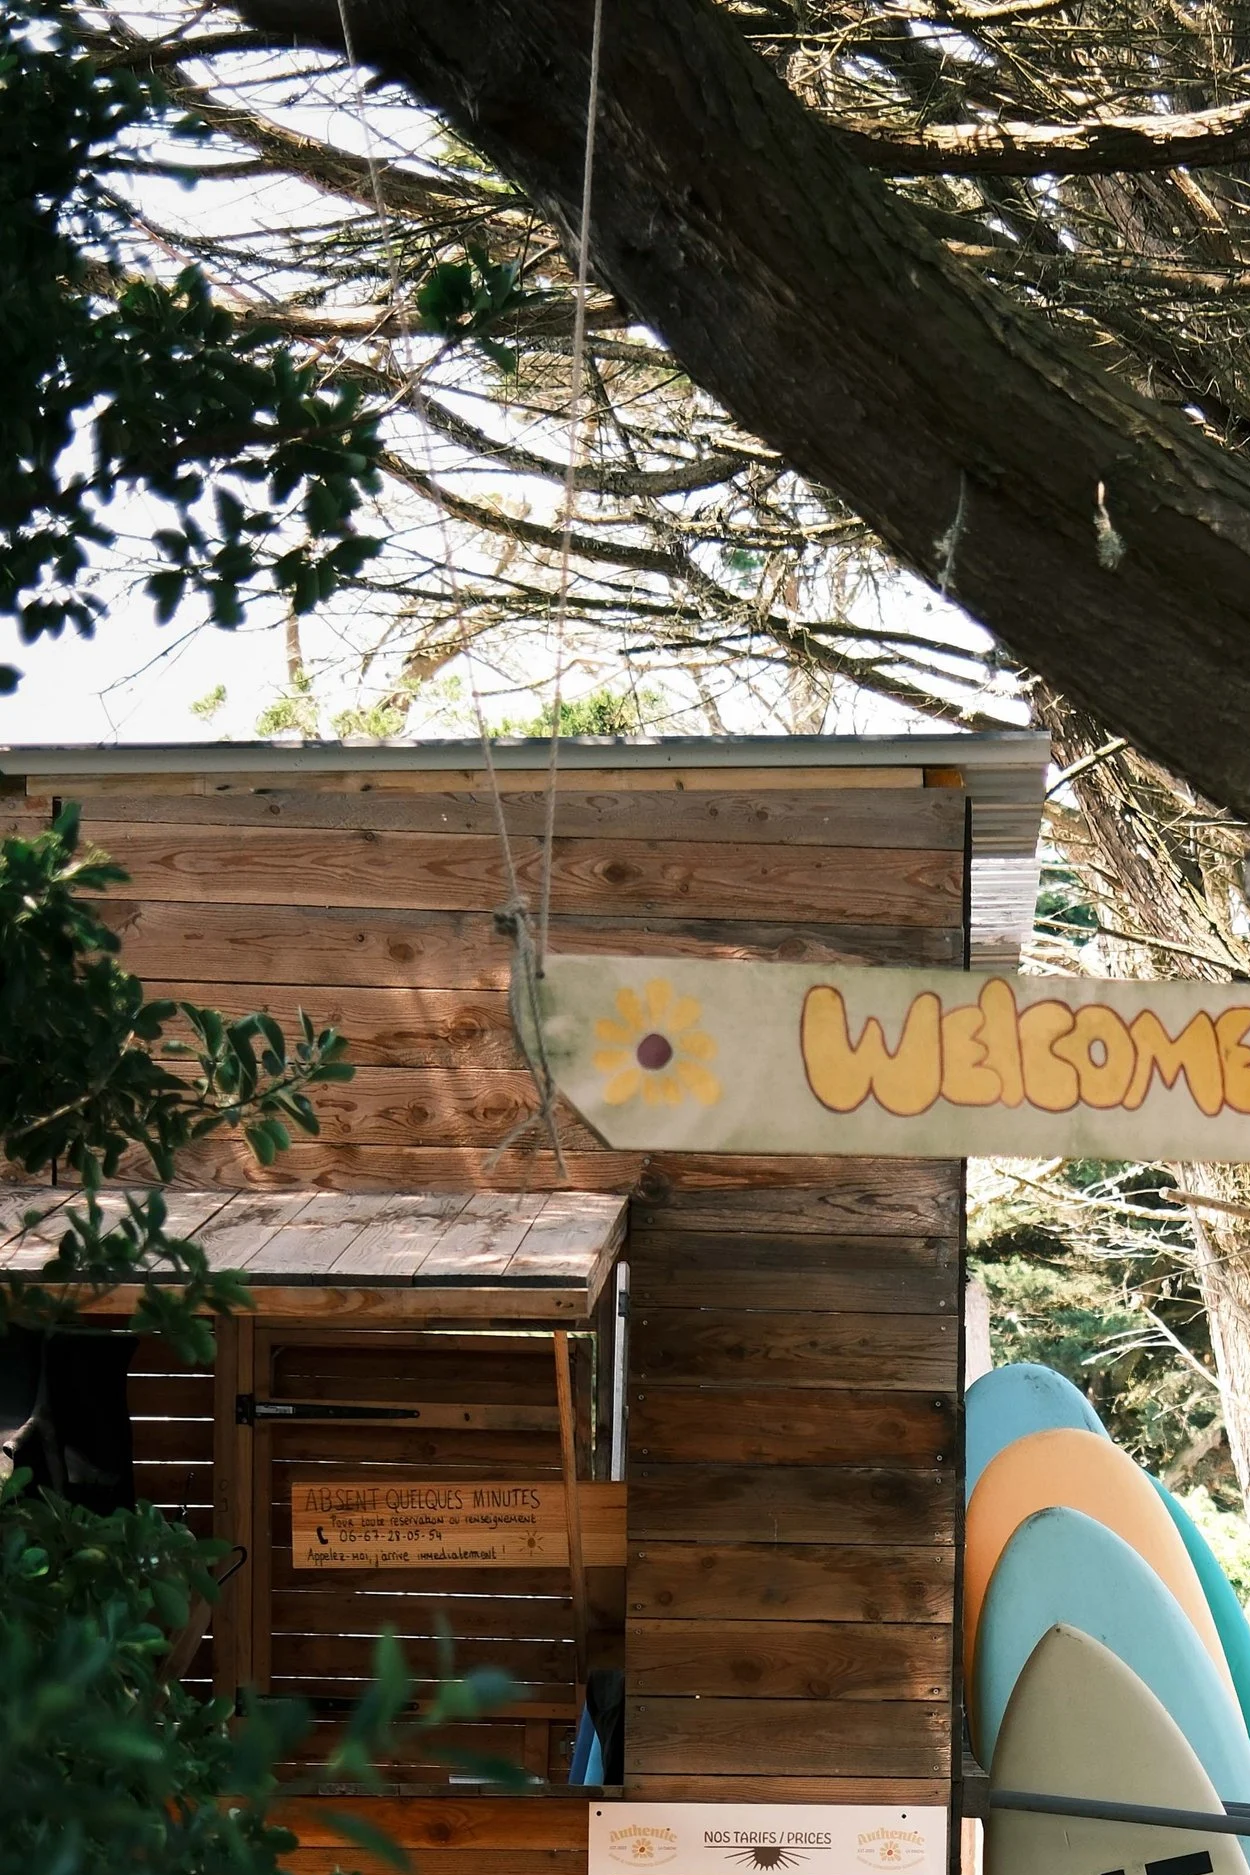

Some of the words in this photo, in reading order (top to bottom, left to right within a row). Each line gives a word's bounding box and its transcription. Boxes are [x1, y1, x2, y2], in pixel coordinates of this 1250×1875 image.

[306, 1487, 379, 1511] ABSENT
[386, 1488, 463, 1512] QUELQUES
[473, 1488, 541, 1509] MINUTES
[361, 1515, 385, 1527] toute
[449, 1515, 460, 1525] ou
[609, 1824, 678, 1843] Authentic
[704, 1831, 730, 1843] NOS
[733, 1831, 777, 1843] TARIFS
[779, 1832, 785, 1844] /
[787, 1832, 832, 1845] PRICES
[857, 1827, 925, 1846] Authentic
